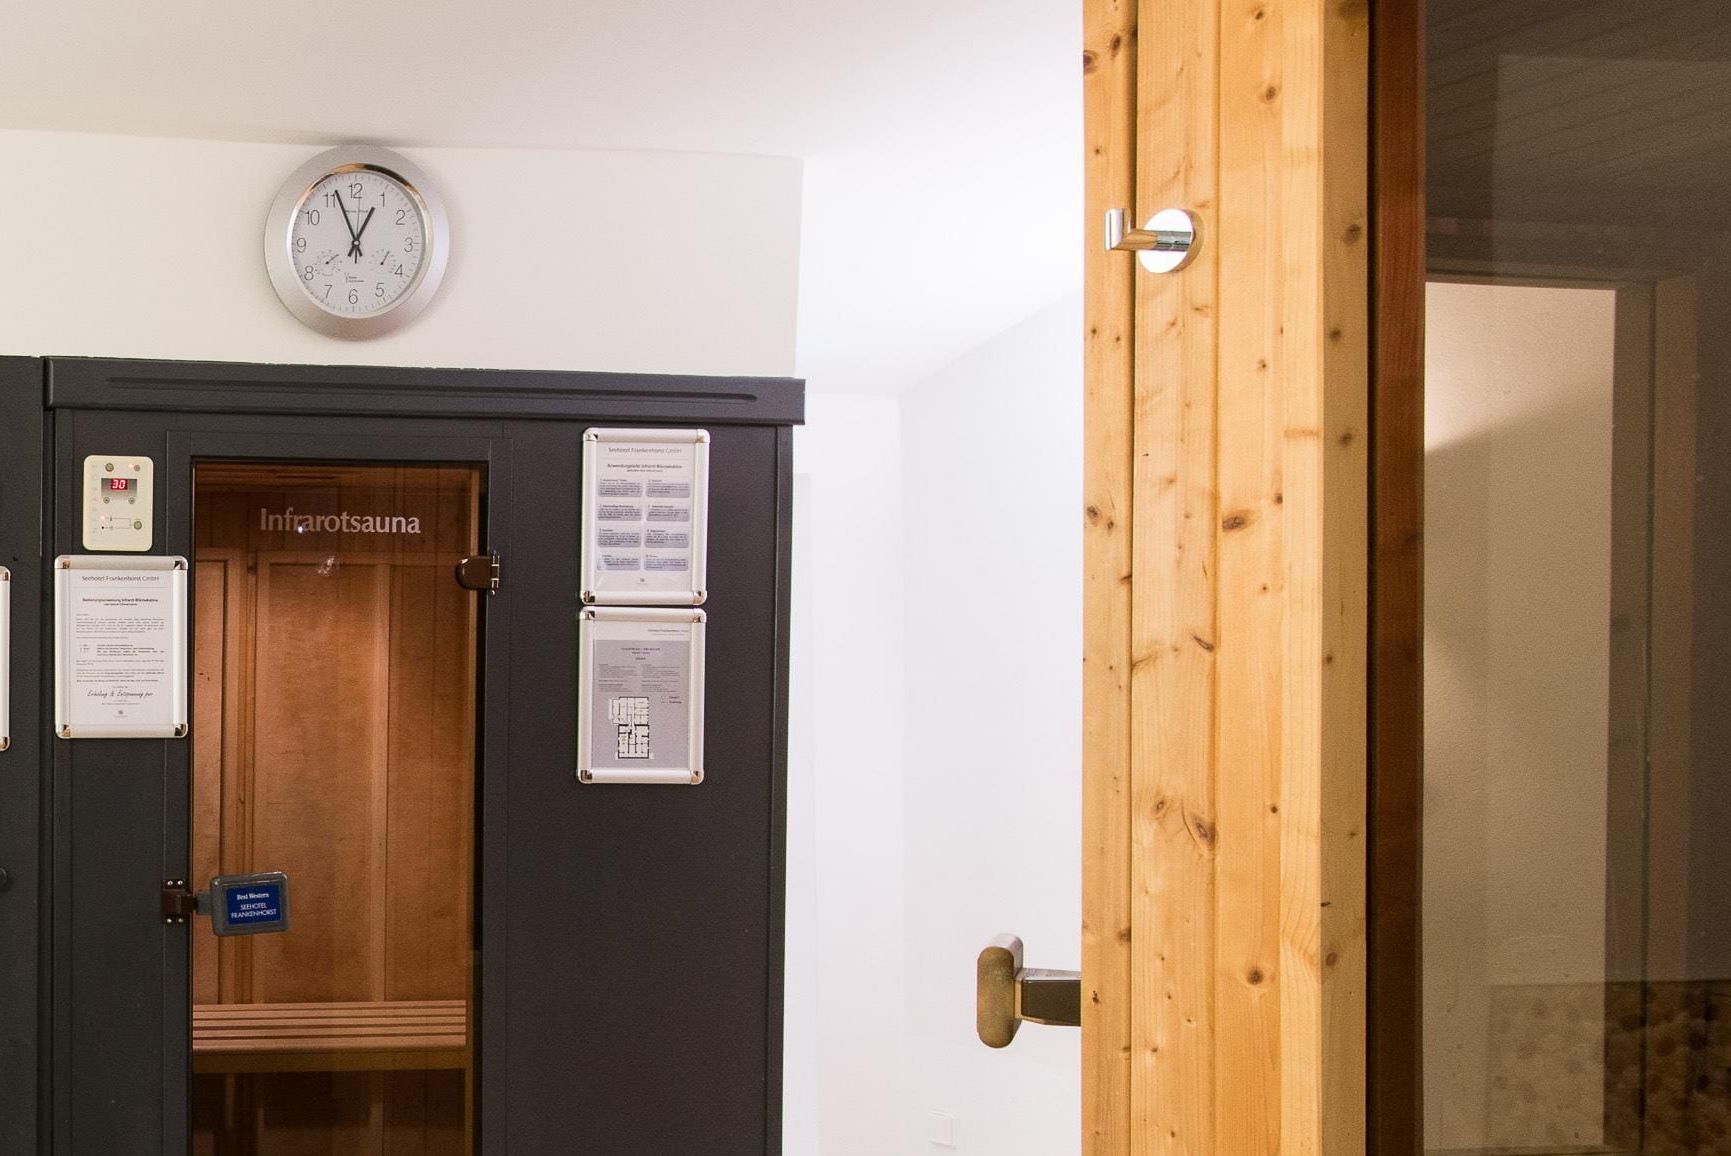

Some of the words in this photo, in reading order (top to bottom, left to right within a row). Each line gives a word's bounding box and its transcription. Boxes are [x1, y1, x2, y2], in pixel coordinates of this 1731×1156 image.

[348, 182, 363, 199] 12
[324, 193, 337, 208] 11
[380, 193, 386, 208] 1
[306, 209, 321, 226] 10
[396, 209, 406, 226] 2
[296, 237, 307, 253] 9
[404, 237, 414, 253] 3
[304, 265, 315, 281] 8
[394, 264, 404, 278] 4
[324, 284, 333, 298] 7
[348, 289, 359, 304] 6
[375, 283, 385, 297] 5
[112, 479, 126, 489] 30
[260, 506, 422, 534] Infrarotsauna
[231, 908, 277, 919] FRANKENHORST
[240, 902, 267, 910] SEEHOTEL
